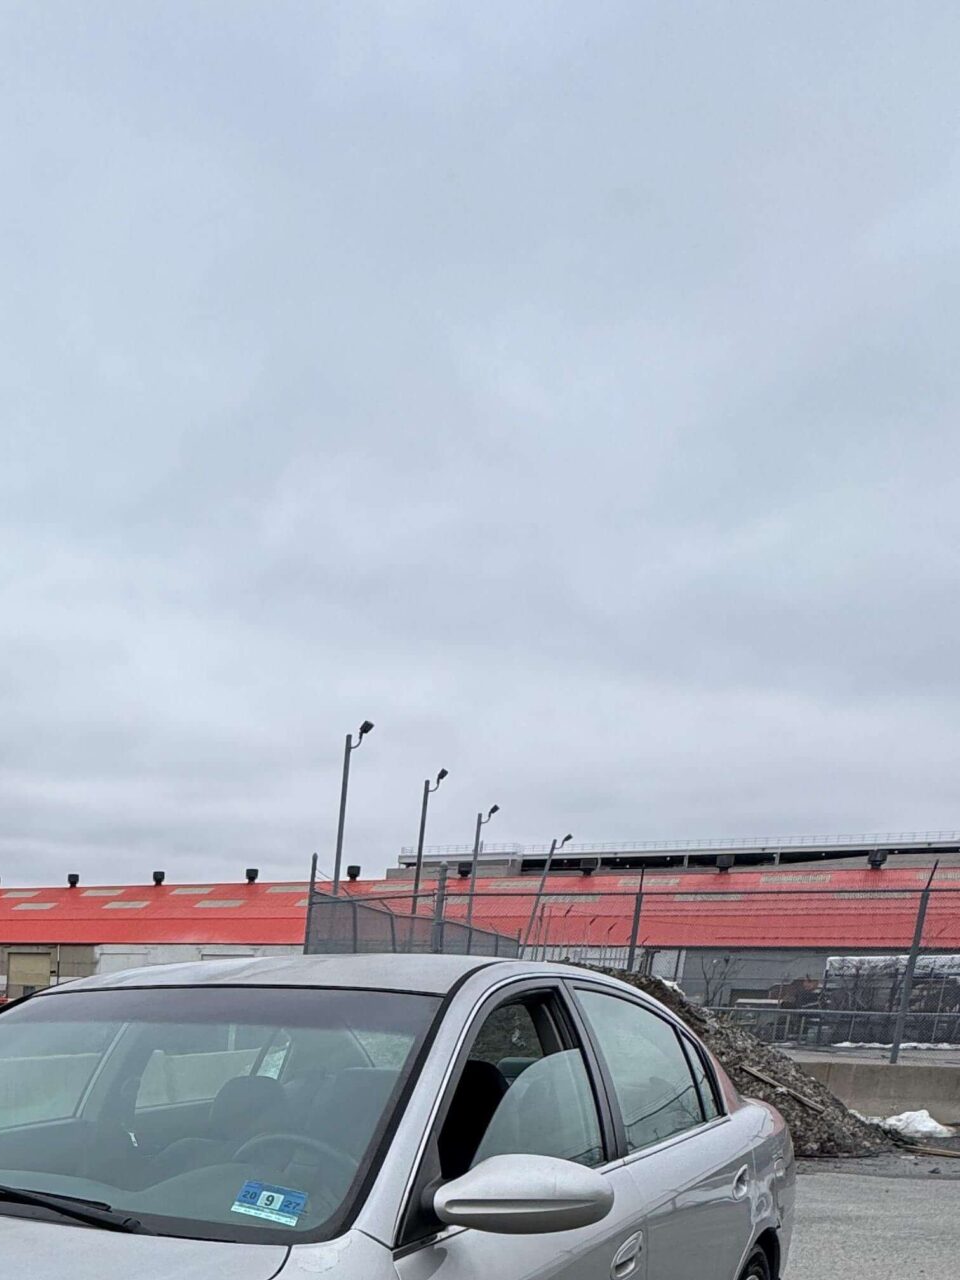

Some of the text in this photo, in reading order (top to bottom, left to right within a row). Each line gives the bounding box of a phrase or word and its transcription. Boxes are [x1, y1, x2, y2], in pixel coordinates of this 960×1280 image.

[242, 1190, 301, 1210] 20 9 27
